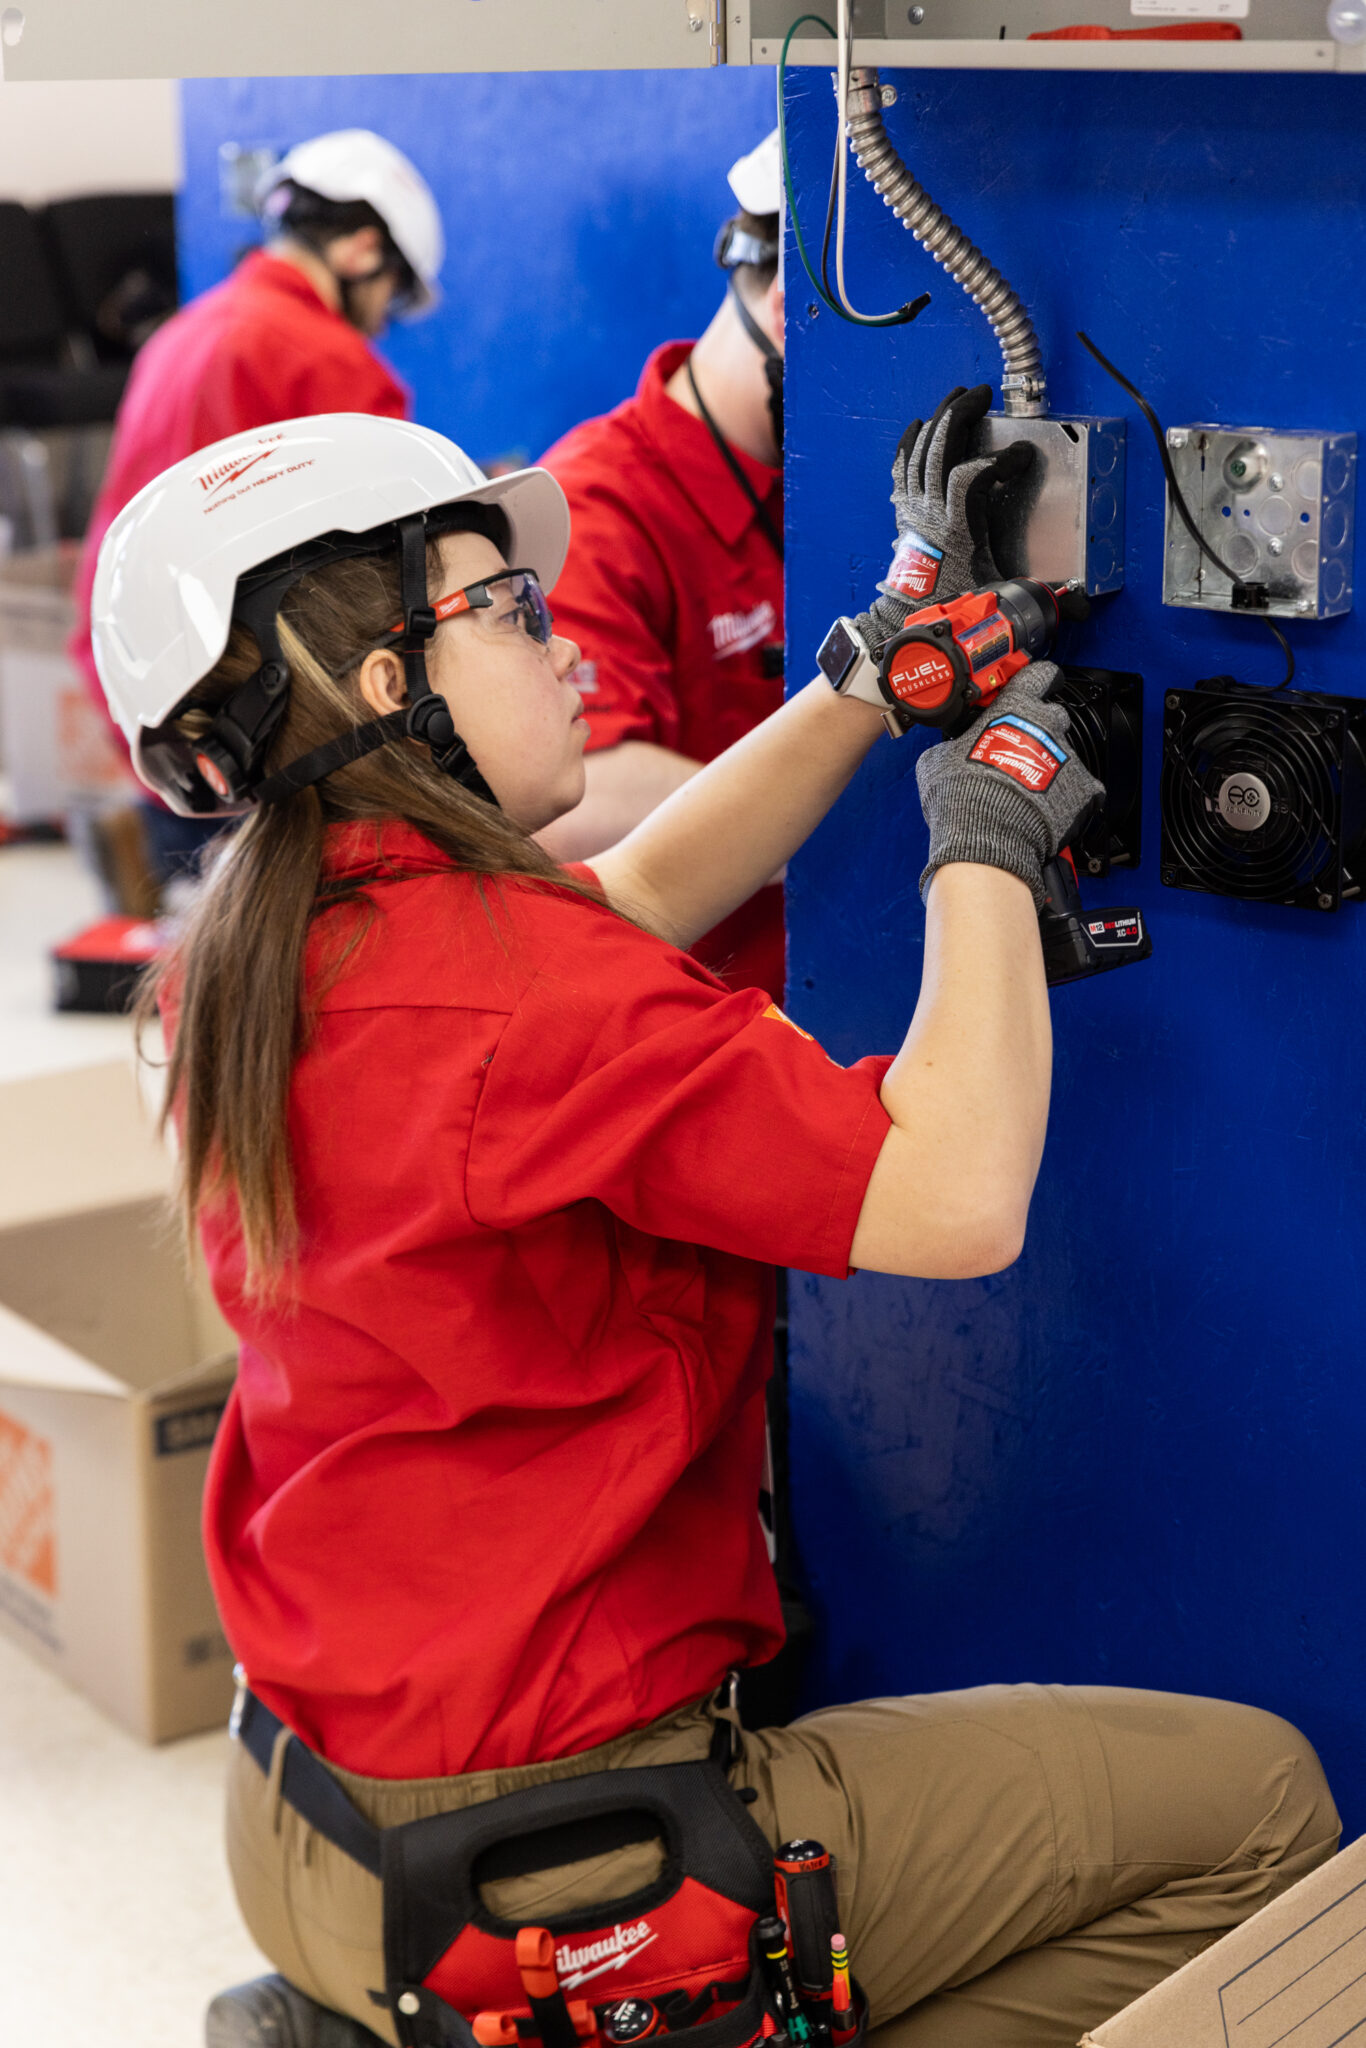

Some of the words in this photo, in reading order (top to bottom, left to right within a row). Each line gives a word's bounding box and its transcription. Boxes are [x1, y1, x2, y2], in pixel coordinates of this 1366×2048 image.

[252, 470, 285, 487] HEAVY
[286, 459, 315, 474] DUTY
[891, 660, 947, 687] FUEL
[896, 670, 951, 696] BRUSHLESS
[989, 752, 1044, 786] Milwaukee
[1089, 923, 1104, 934] M12
[555, 1920, 652, 1974] ilwaukee
